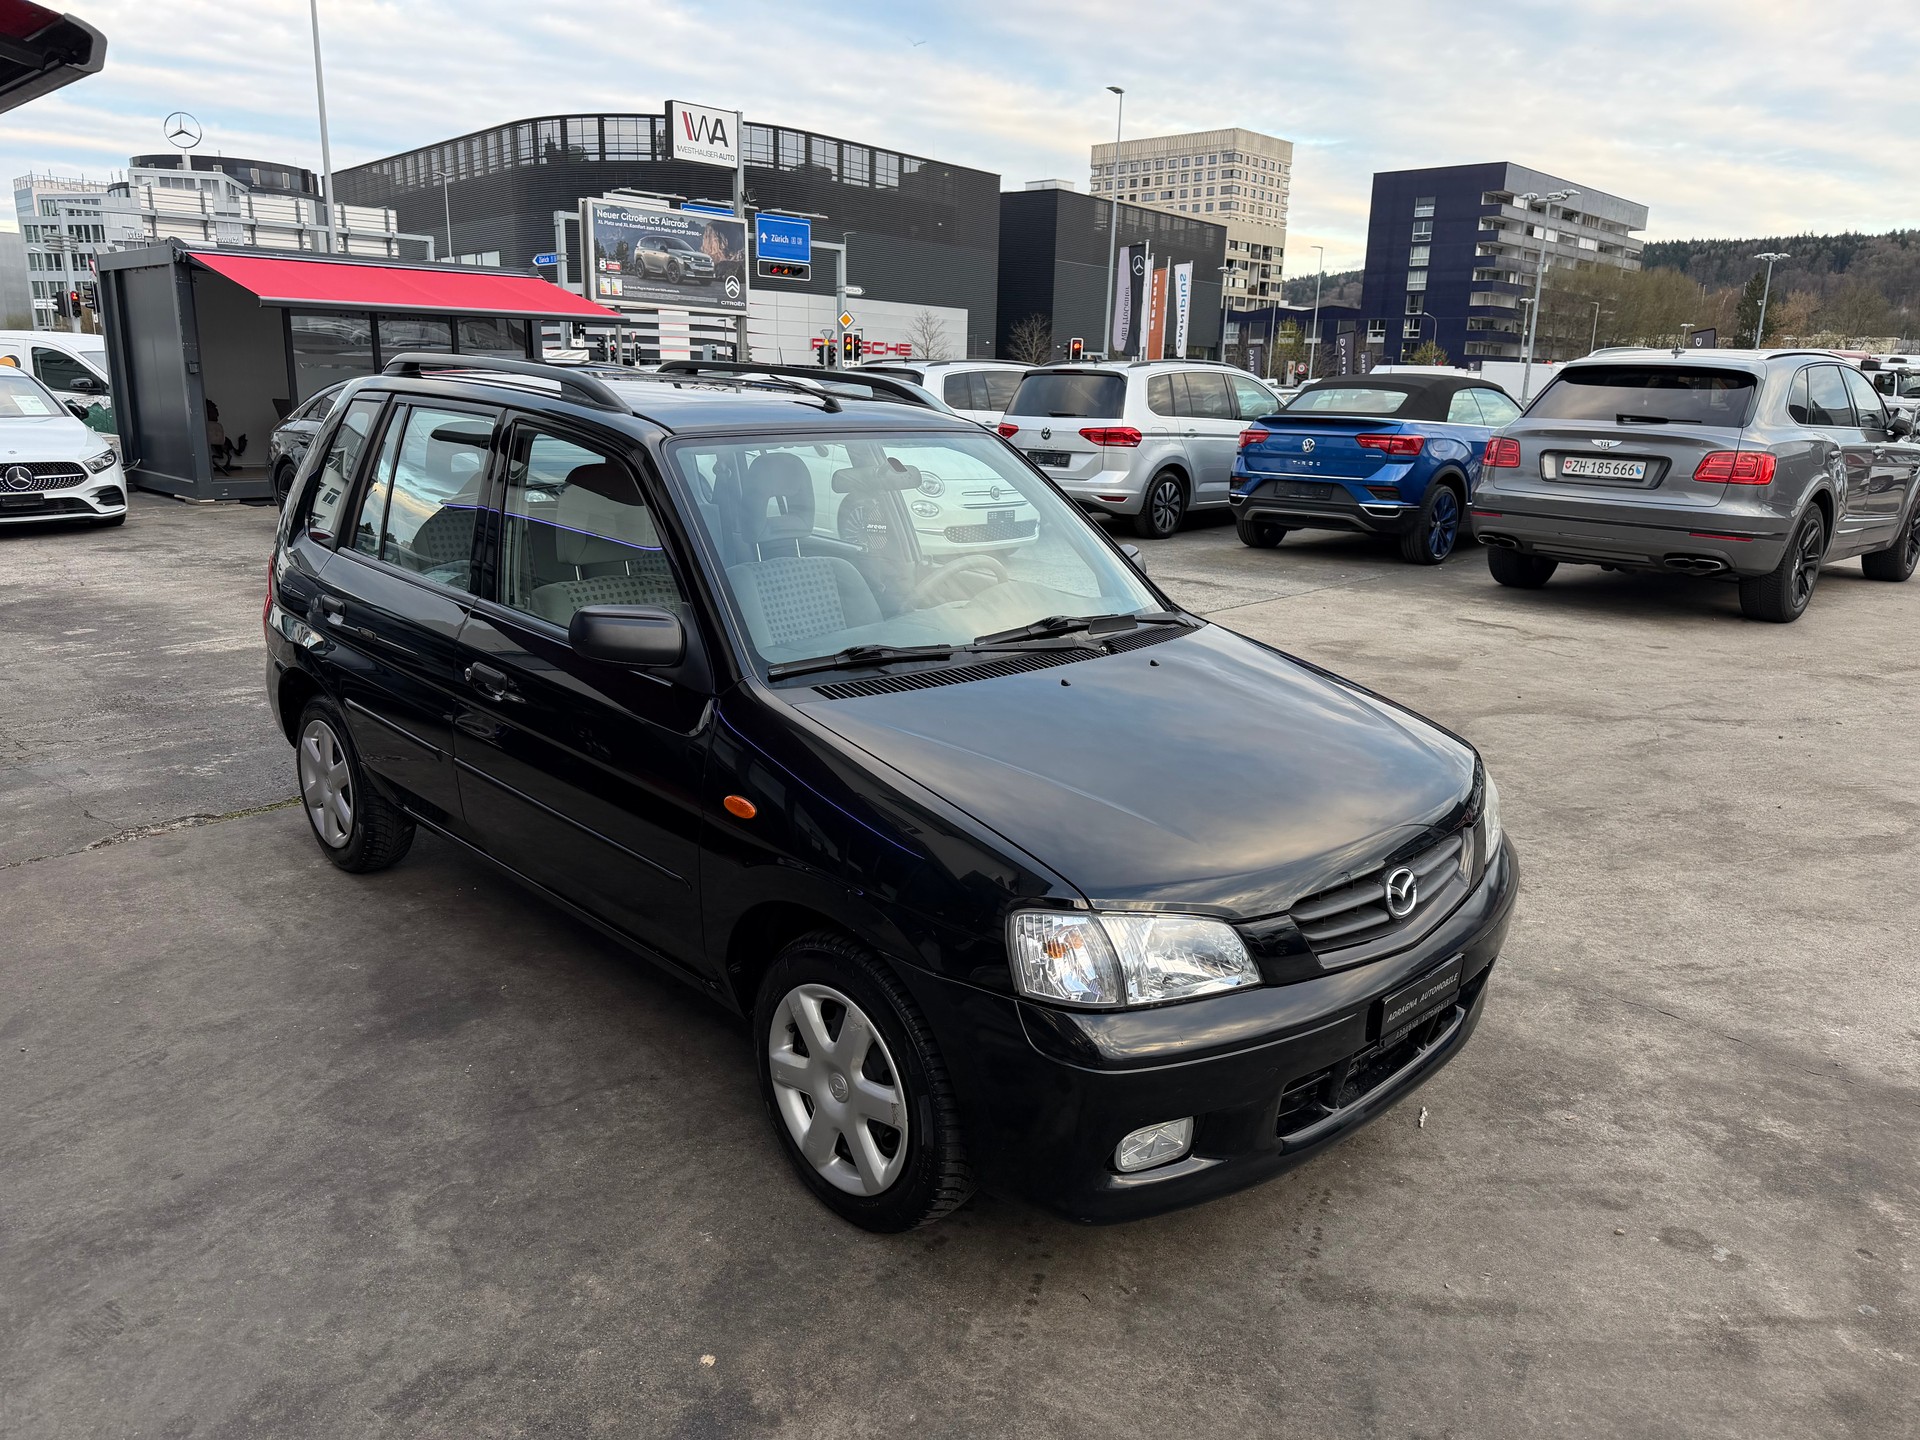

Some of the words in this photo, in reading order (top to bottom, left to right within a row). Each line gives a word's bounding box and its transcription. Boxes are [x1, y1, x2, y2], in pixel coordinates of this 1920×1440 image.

[597, 209, 620, 220] Neuer
[620, 212, 648, 224] Citroën
[649, 216, 660, 225] C5
[661, 217, 689, 229] Aircross
[771, 233, 790, 244] Zürich
[811, 338, 912, 356] PSCHE
[1387, 997, 1418, 1023] ADRAGNA
[1420, 972, 1458, 1003] AUTOMOBILE
